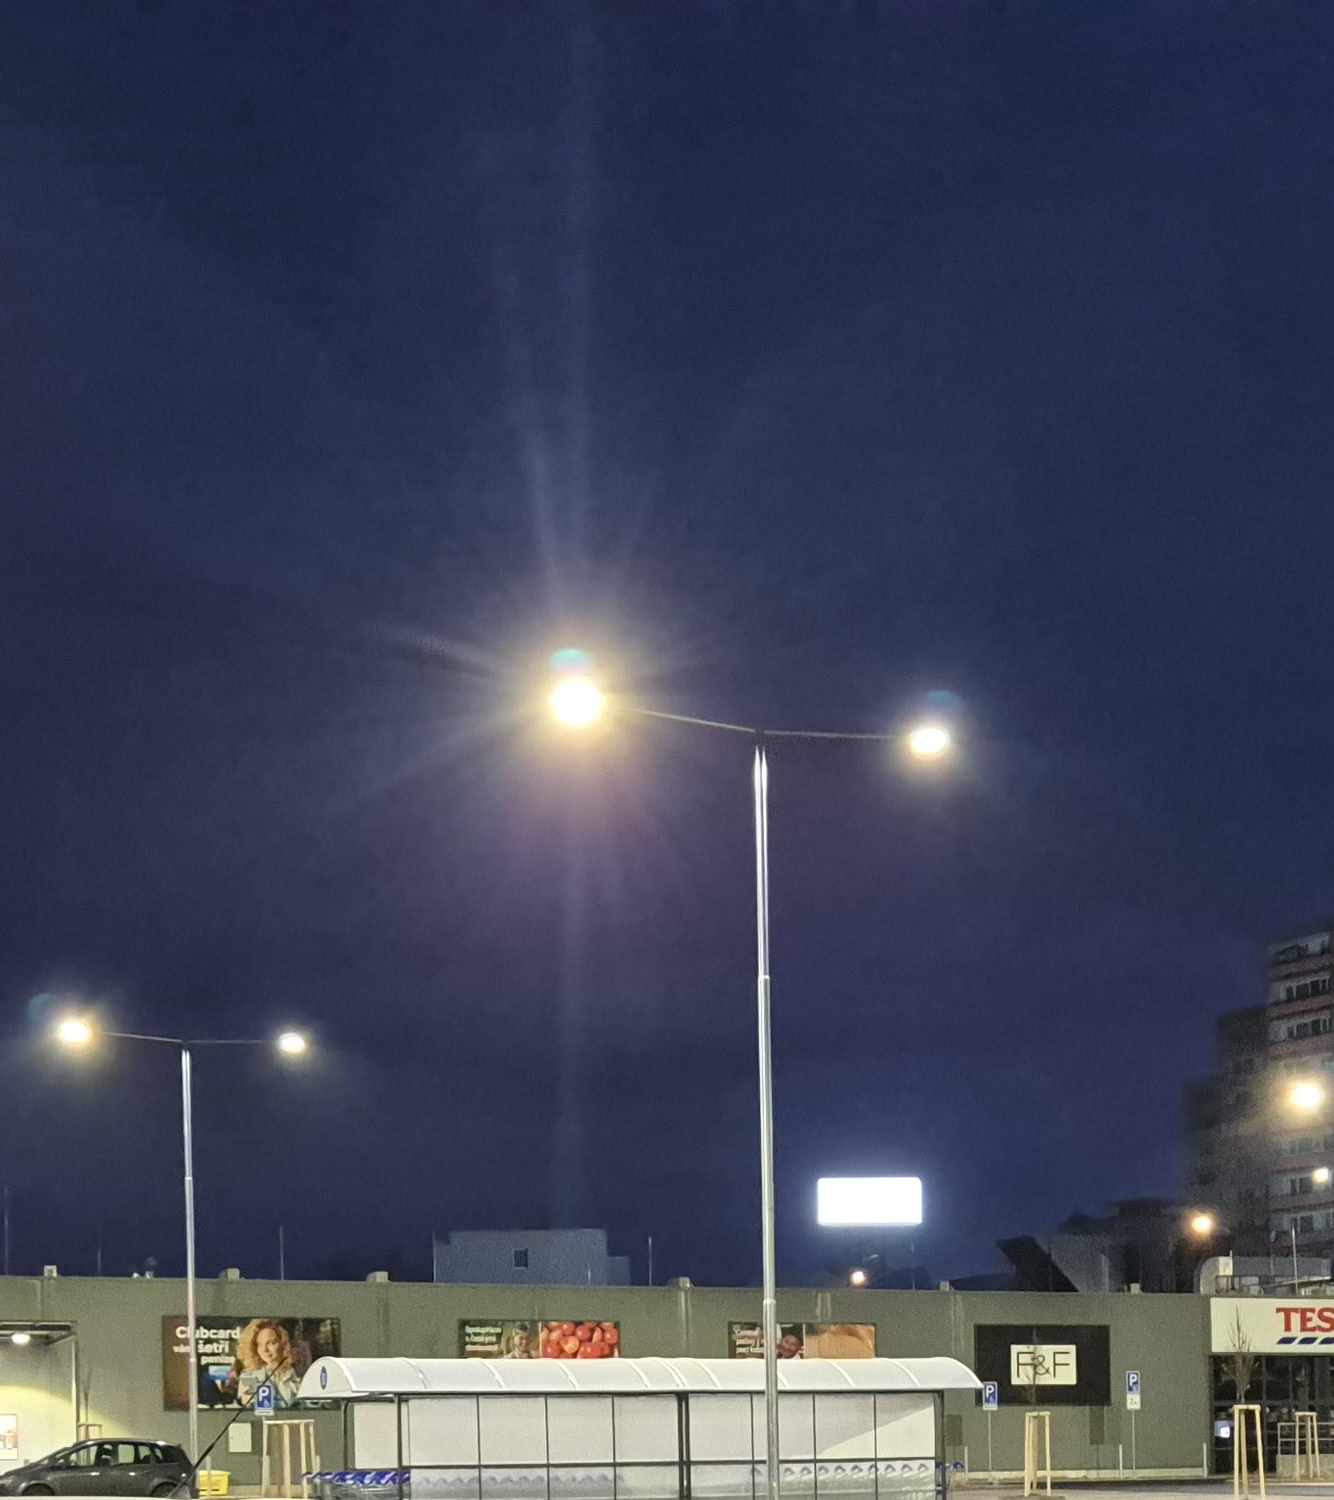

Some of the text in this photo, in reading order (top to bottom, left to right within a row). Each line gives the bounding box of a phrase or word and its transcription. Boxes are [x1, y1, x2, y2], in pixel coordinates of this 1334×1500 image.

[1017, 1351, 1071, 1379] F&F
[1129, 1373, 1138, 1386] P
[258, 1386, 270, 1401] P
[985, 1385, 995, 1398] P
